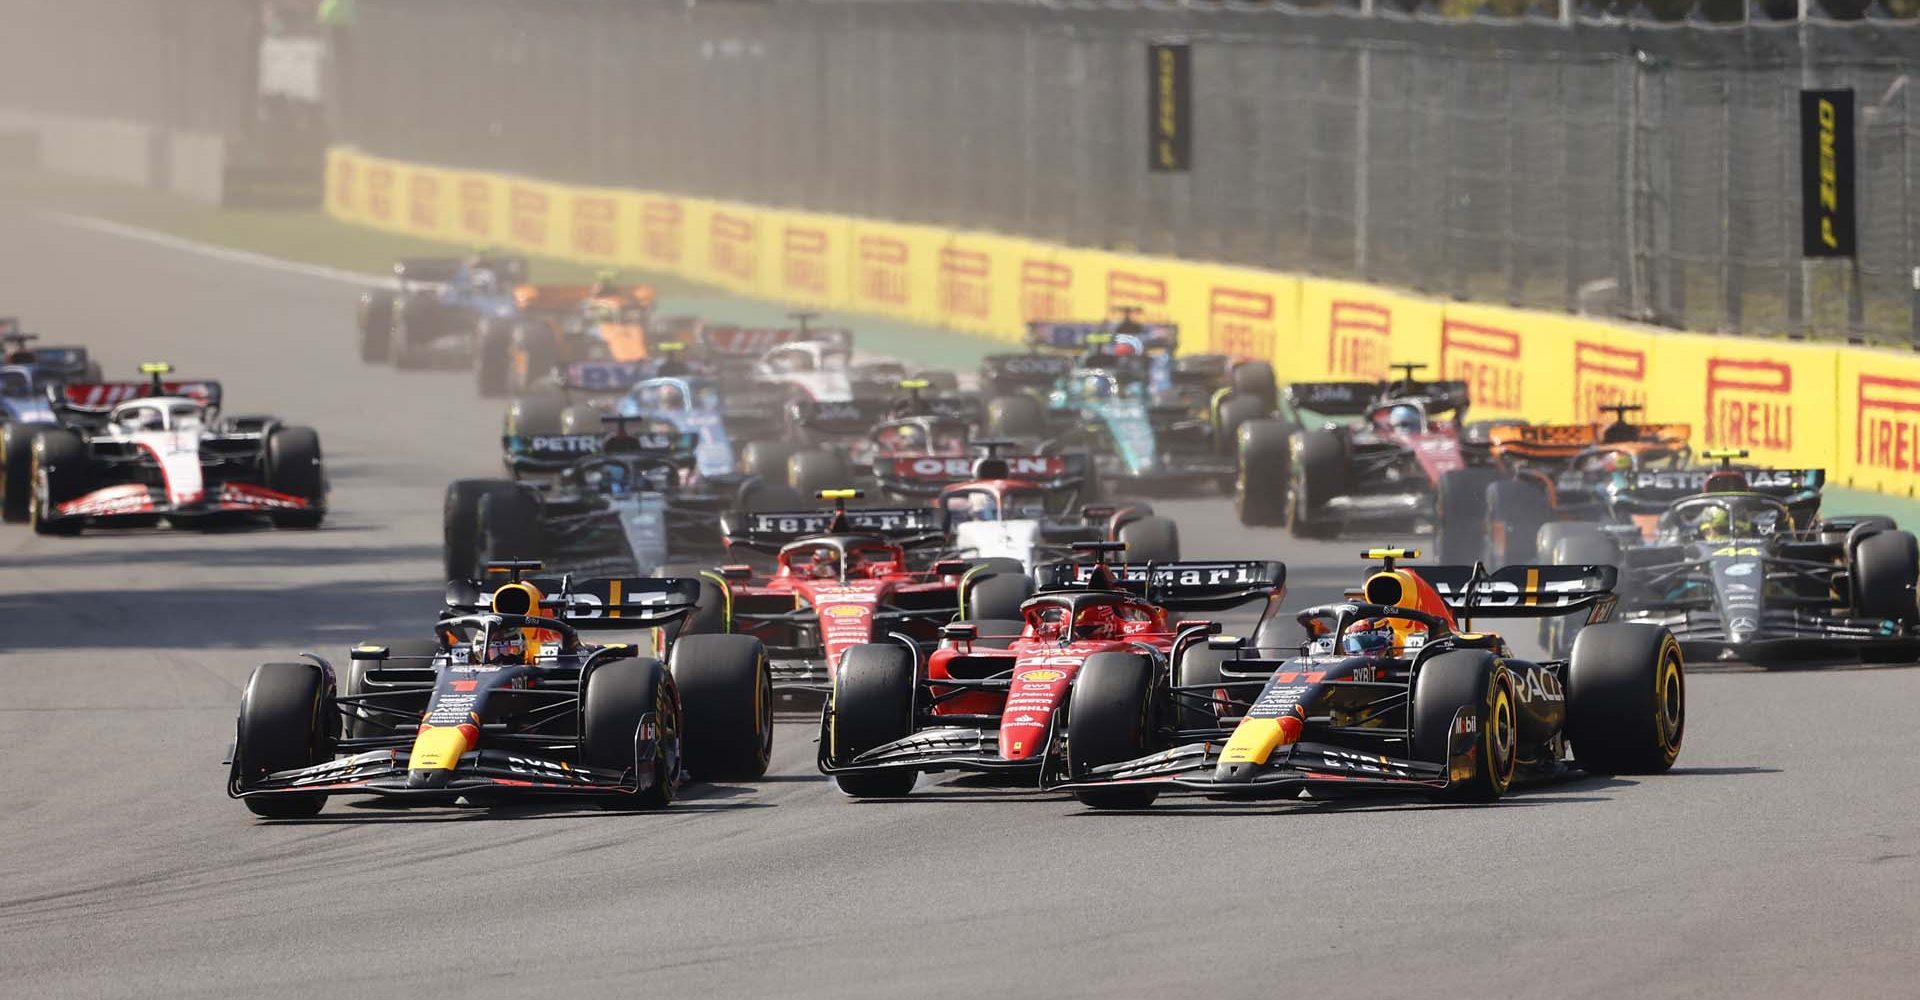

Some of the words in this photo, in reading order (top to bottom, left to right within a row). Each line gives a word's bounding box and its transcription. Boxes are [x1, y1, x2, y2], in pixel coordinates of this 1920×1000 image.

[1819, 98, 1837, 212] ZERO
[1821, 217, 1838, 248] P
[1705, 359, 1792, 451] PIRELLI
[532, 436, 669, 451] PETRAS
[913, 458, 1048, 475] ORN
[1637, 470, 1793, 489] PETRAS
[756, 512, 917, 534] Ferari
[1712, 547, 1761, 557] 44
[1077, 565, 1252, 585] Frrari
[1435, 569, 1586, 607] YBIT
[448, 680, 479, 692] 1
[1274, 671, 1328, 684] 11
[1456, 716, 1477, 734] Mobil
